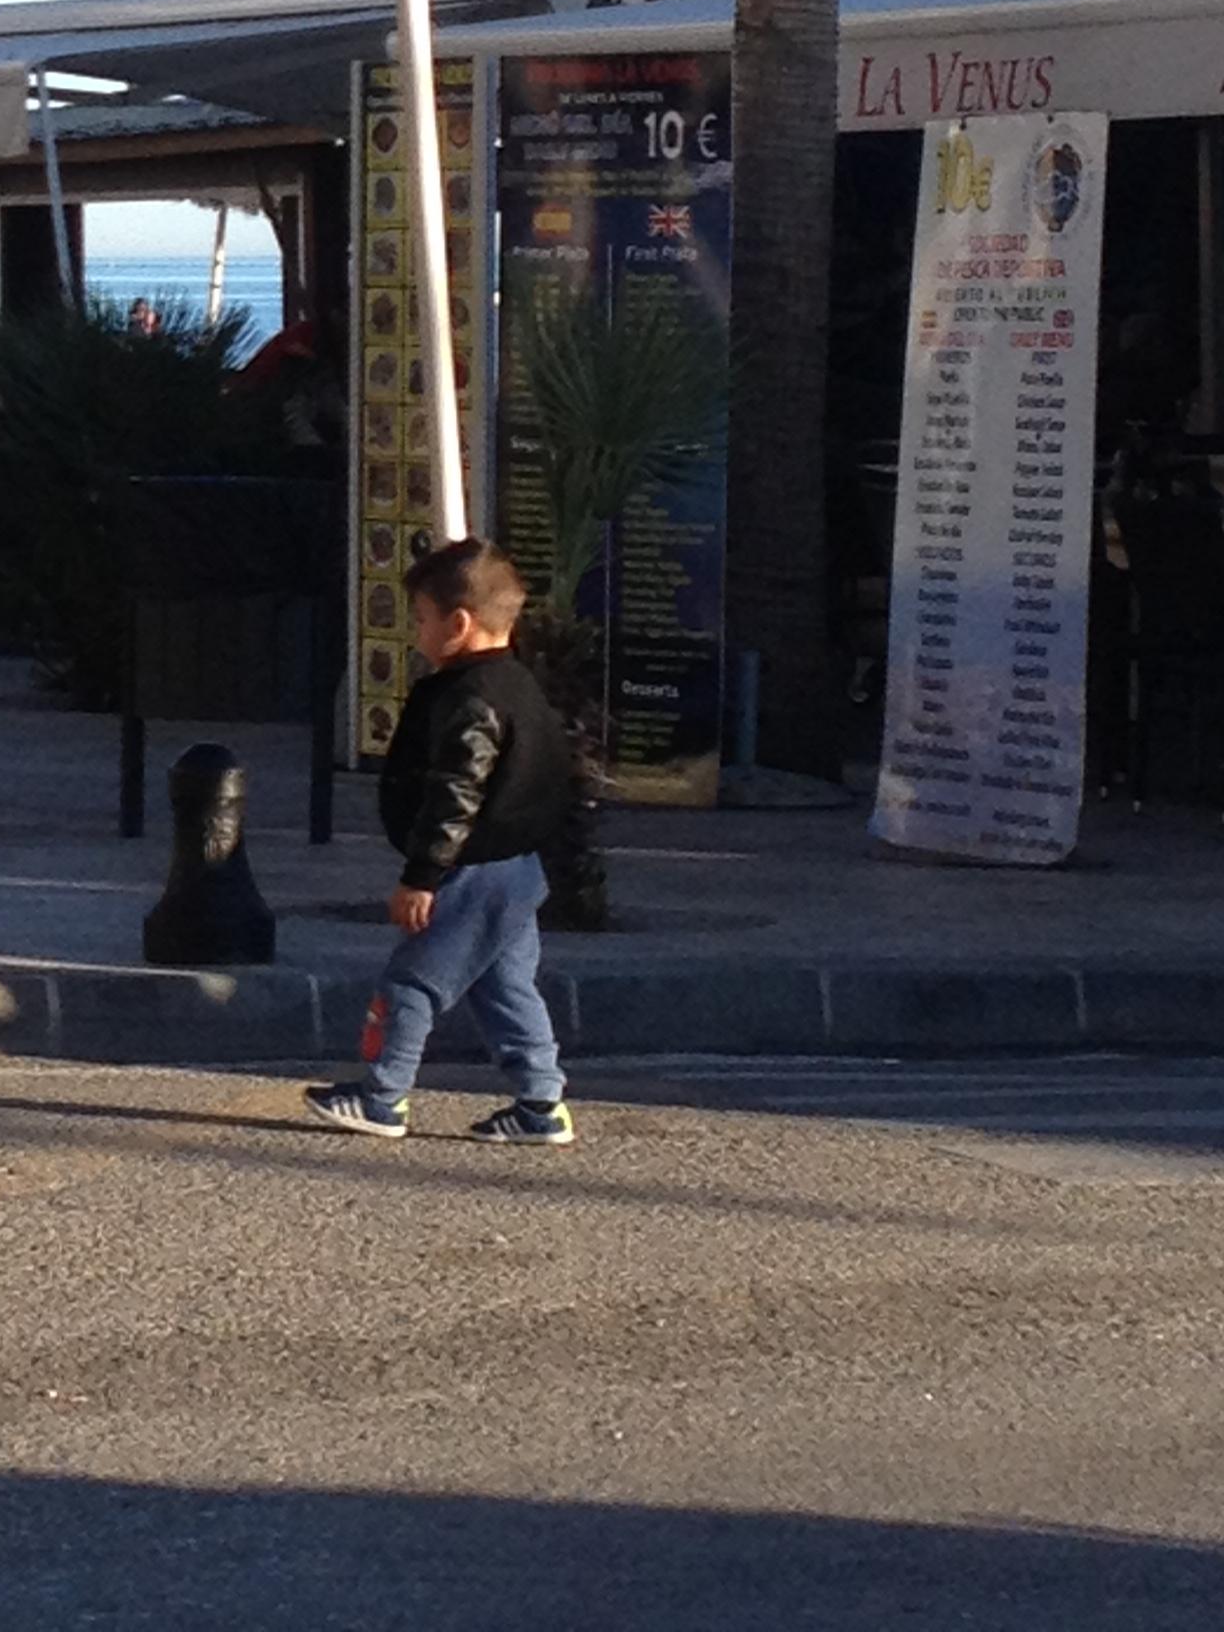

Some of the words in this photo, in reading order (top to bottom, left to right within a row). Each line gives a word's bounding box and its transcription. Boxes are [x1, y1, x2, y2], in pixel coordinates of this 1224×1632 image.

[857, 56, 906, 118] LA
[927, 50, 1055, 115] VENUS
[643, 110, 685, 160] 10
[696, 112, 719, 159] €
